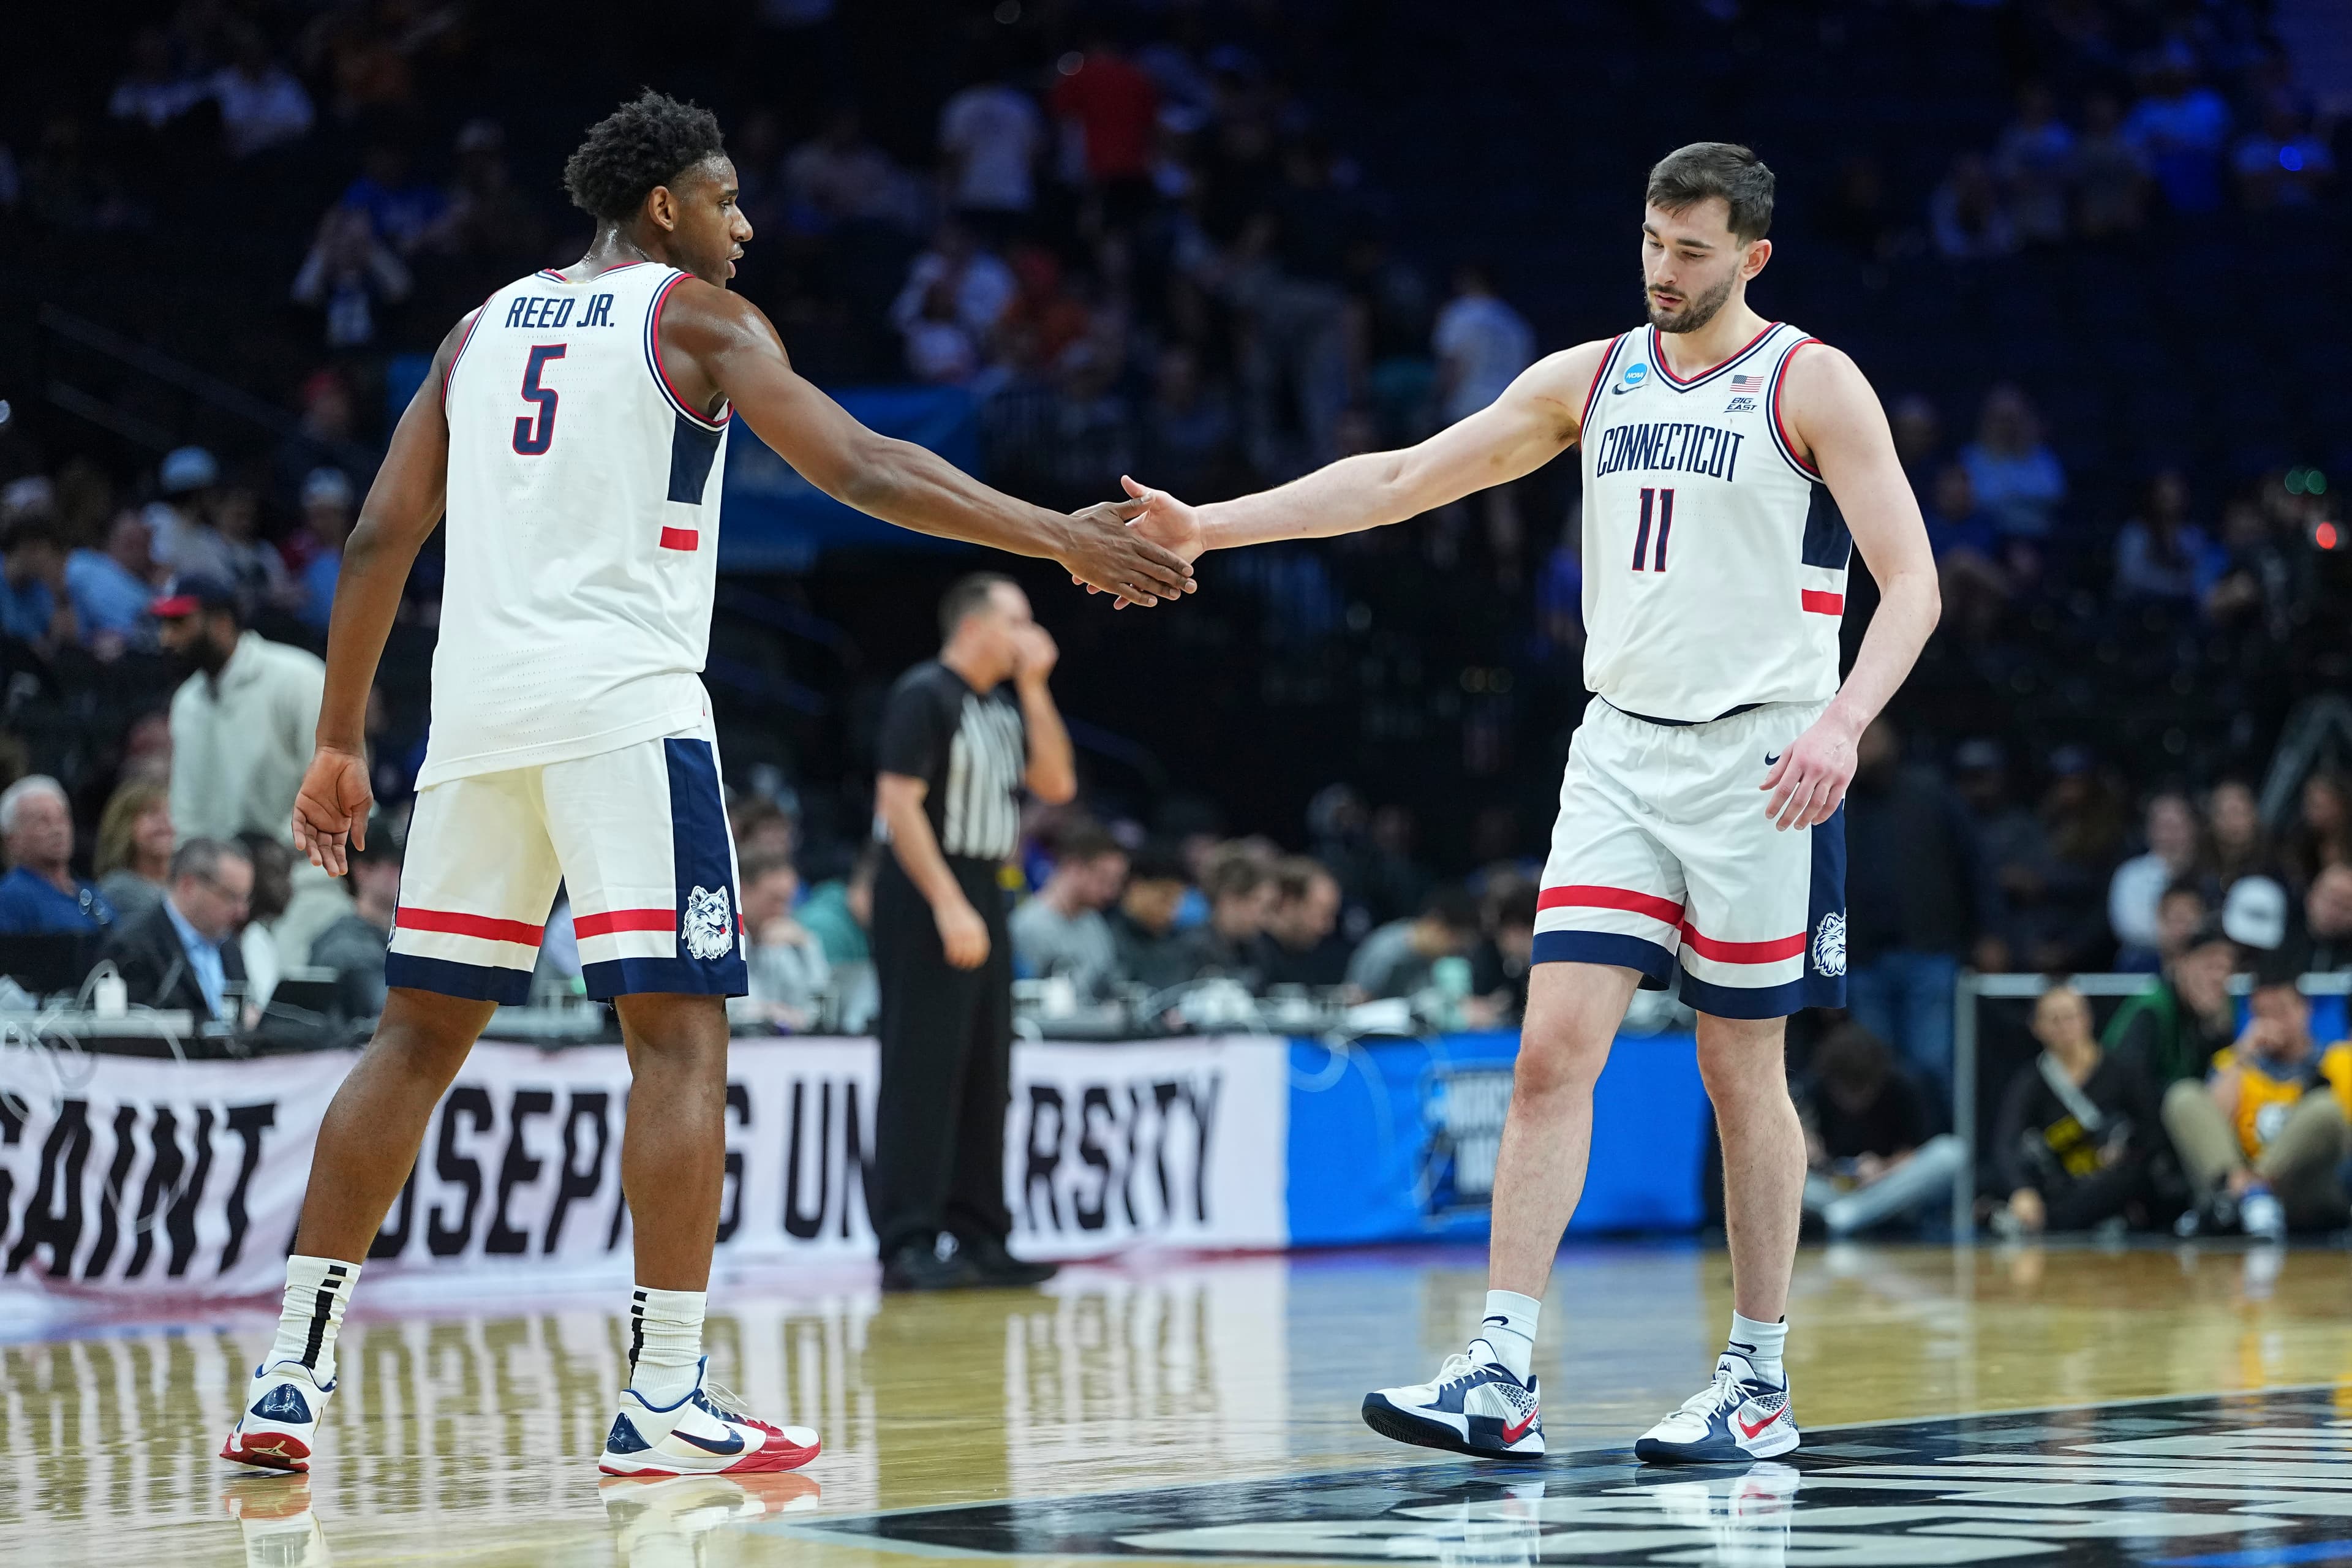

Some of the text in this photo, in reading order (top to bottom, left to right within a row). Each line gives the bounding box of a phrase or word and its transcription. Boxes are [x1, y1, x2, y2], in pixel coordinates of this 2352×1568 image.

[505, 293, 615, 328] REED JR.
[512, 343, 567, 456] 5
[1597, 423, 1745, 483] CONNECTICUT
[1631, 488, 1675, 572] 11
